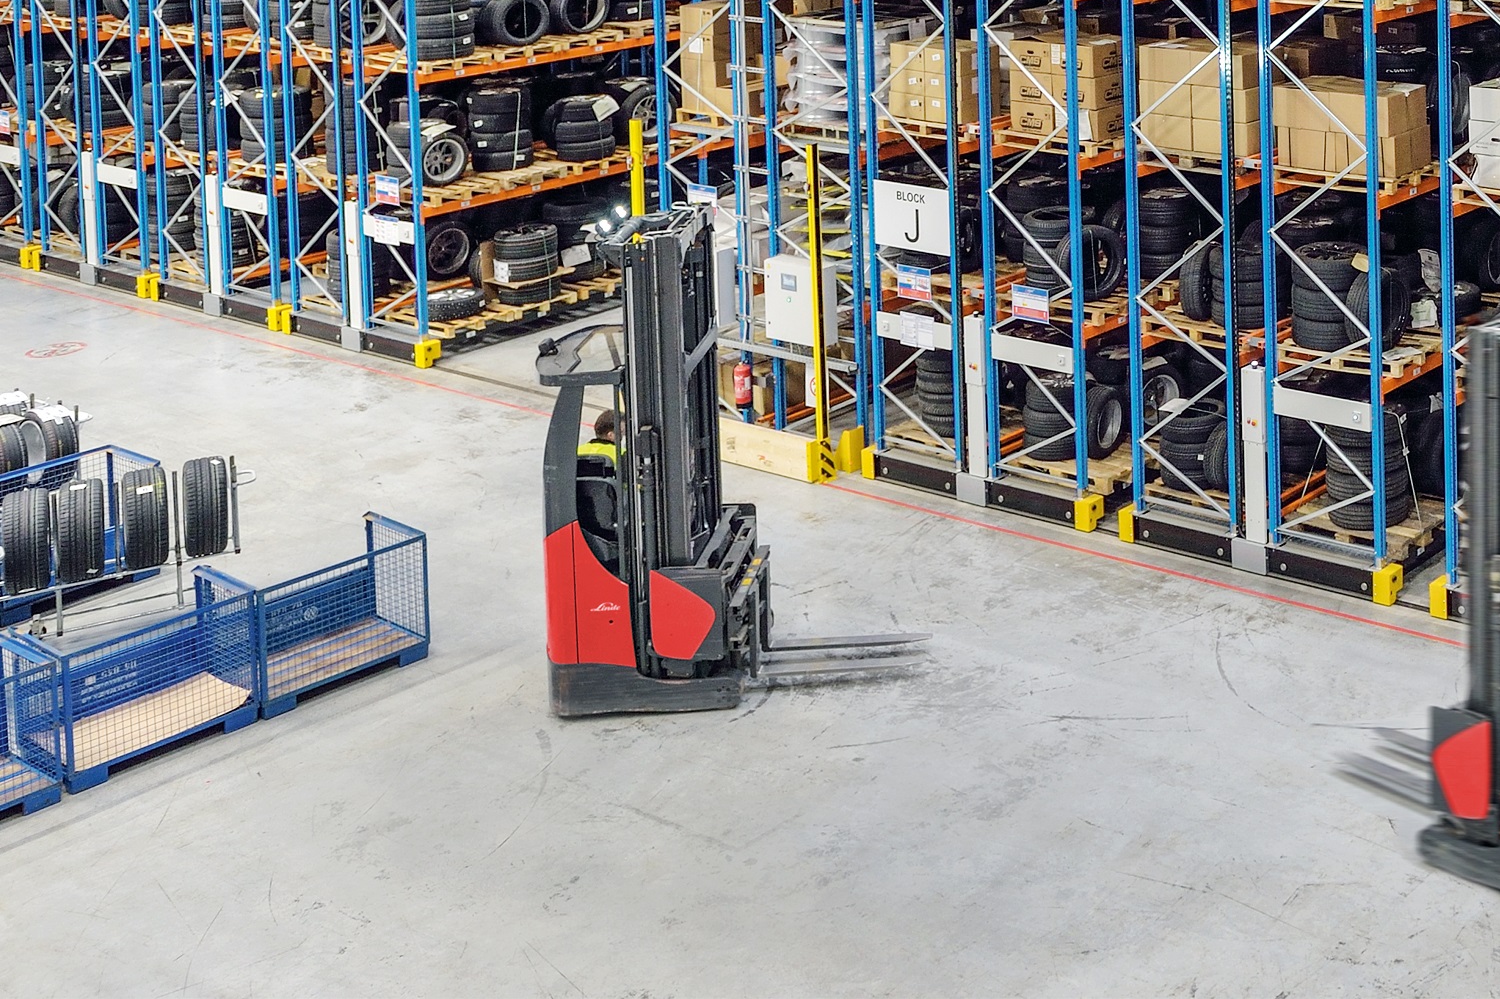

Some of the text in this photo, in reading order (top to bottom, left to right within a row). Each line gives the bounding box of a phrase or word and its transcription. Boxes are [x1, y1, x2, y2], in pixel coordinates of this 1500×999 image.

[896, 190, 926, 204] BLOCK
[904, 208, 920, 243] J
[590, 601, 621, 612] Linde
